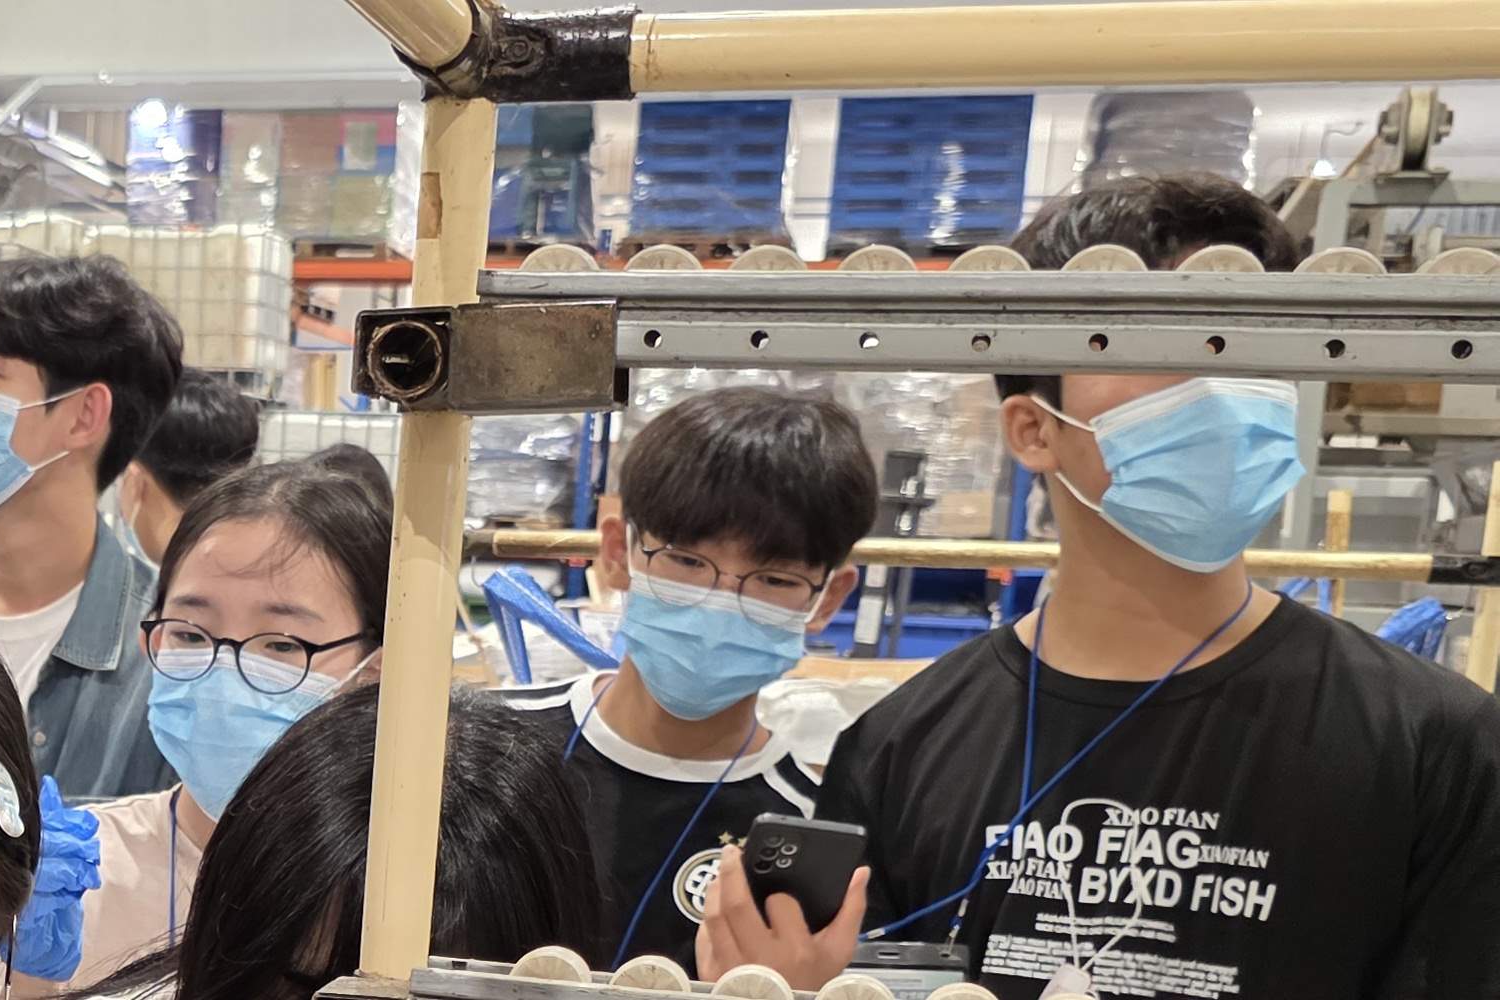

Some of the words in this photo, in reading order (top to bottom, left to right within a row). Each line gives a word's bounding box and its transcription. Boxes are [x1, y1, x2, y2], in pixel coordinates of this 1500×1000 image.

[1161, 807, 1220, 831] FIAN
[1095, 827, 1201, 869] FIAG
[1078, 865, 1183, 908] BYXD
[1189, 873, 1277, 922] FISH
